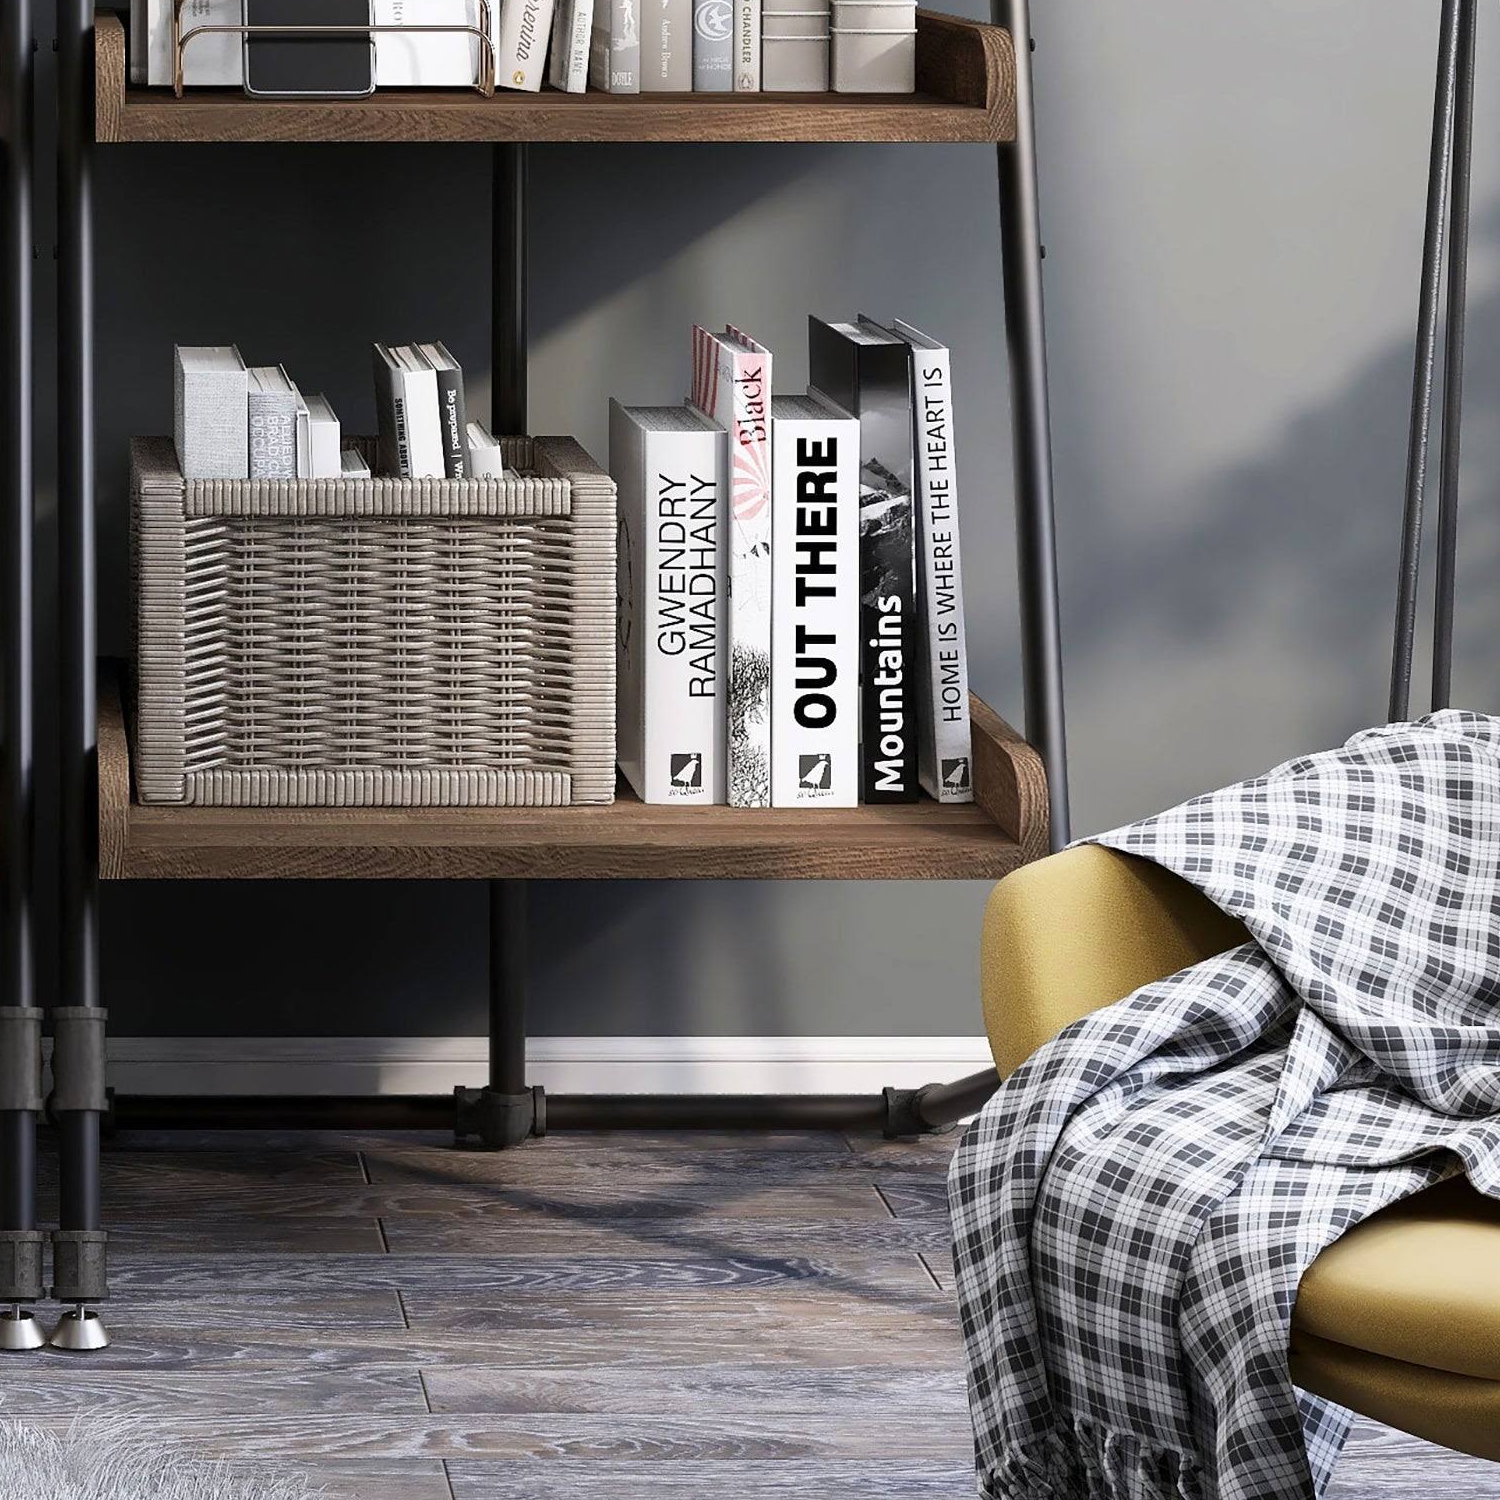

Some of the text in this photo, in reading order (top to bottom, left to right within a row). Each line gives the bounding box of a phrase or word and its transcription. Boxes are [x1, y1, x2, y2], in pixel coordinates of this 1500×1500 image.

[572, 11, 587, 75] AUTHOR NAME
[741, 5, 752, 63] CHANDLER
[268, 416, 280, 457] BRAD
[394, 397, 407, 442] SOMETHING
[734, 366, 768, 447] Black
[398, 444, 409, 469] ABOUT
[657, 473, 687, 656] GWENDRY
[793, 436, 838, 730] OUT THERE
[923, 365, 962, 723] HOME IS WHERE THE HEART IS
[689, 473, 717, 698] RAMADHANY
[872, 594, 906, 793] Mountains
